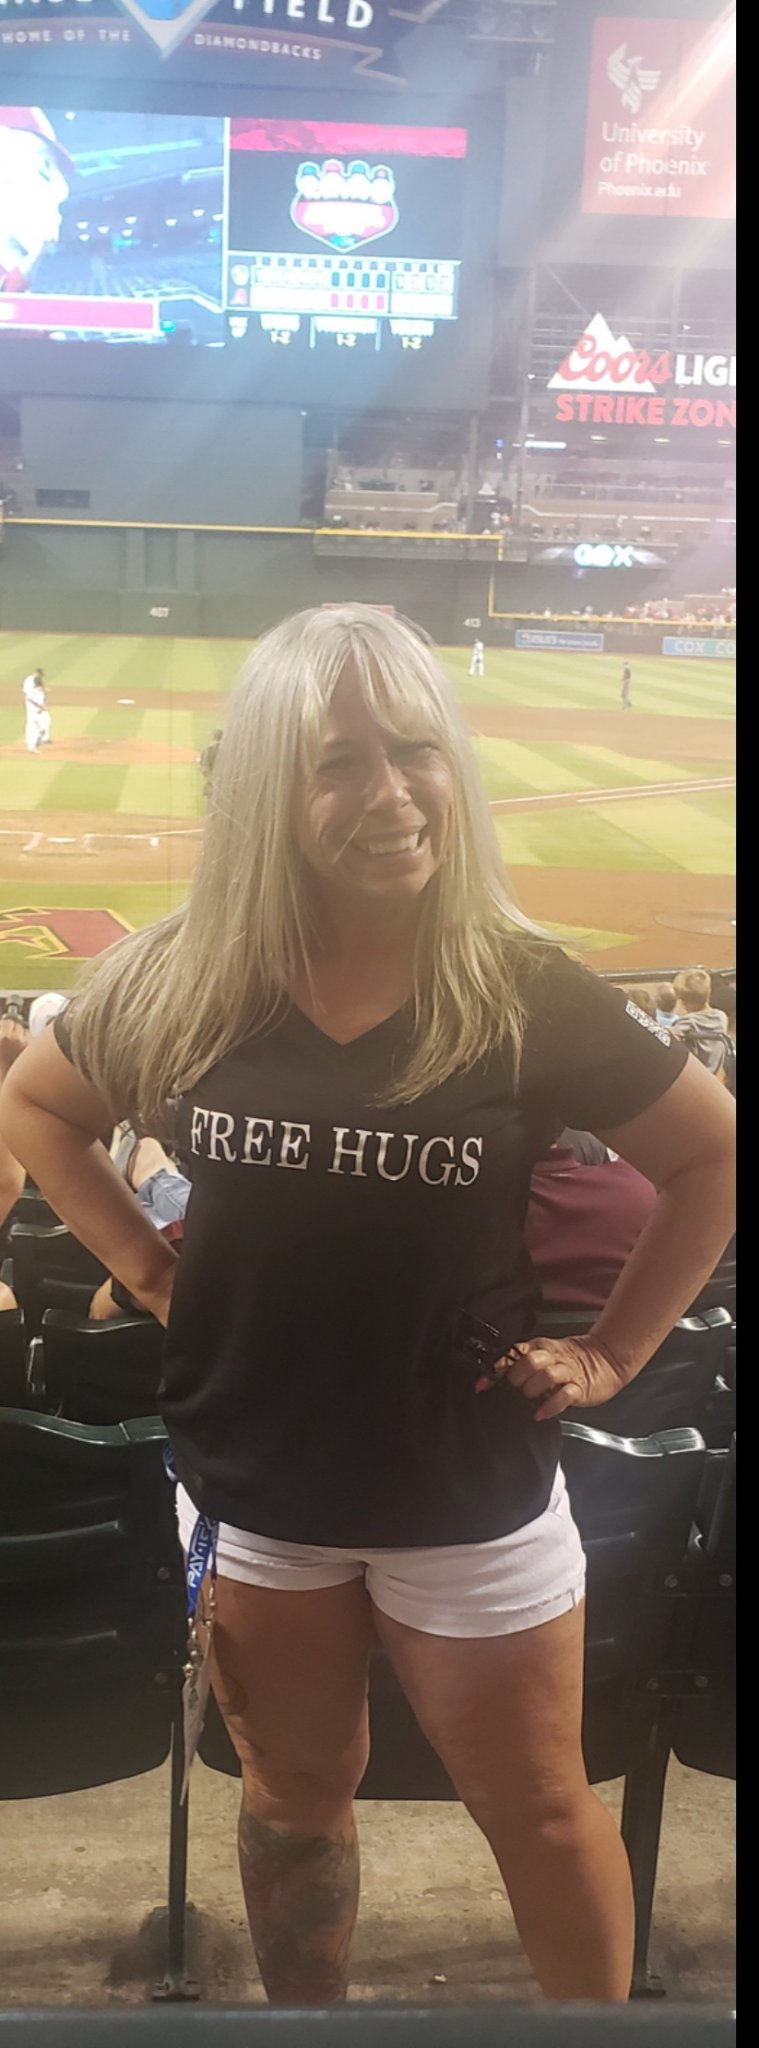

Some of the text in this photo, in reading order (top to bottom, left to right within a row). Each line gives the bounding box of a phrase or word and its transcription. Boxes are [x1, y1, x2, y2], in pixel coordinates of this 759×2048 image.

[2, 29, 130, 43] HOME OF THE
[194, 33, 322, 60] DIAMONDBACKS
[602, 121, 705, 152] University
[600, 151, 707, 176] of Phoenix
[558, 334, 736, 386] Coors LIG
[556, 394, 666, 426] STRIKE
[674, 640, 704, 654] COX
[190, 1105, 483, 1187] FREE HUGS
